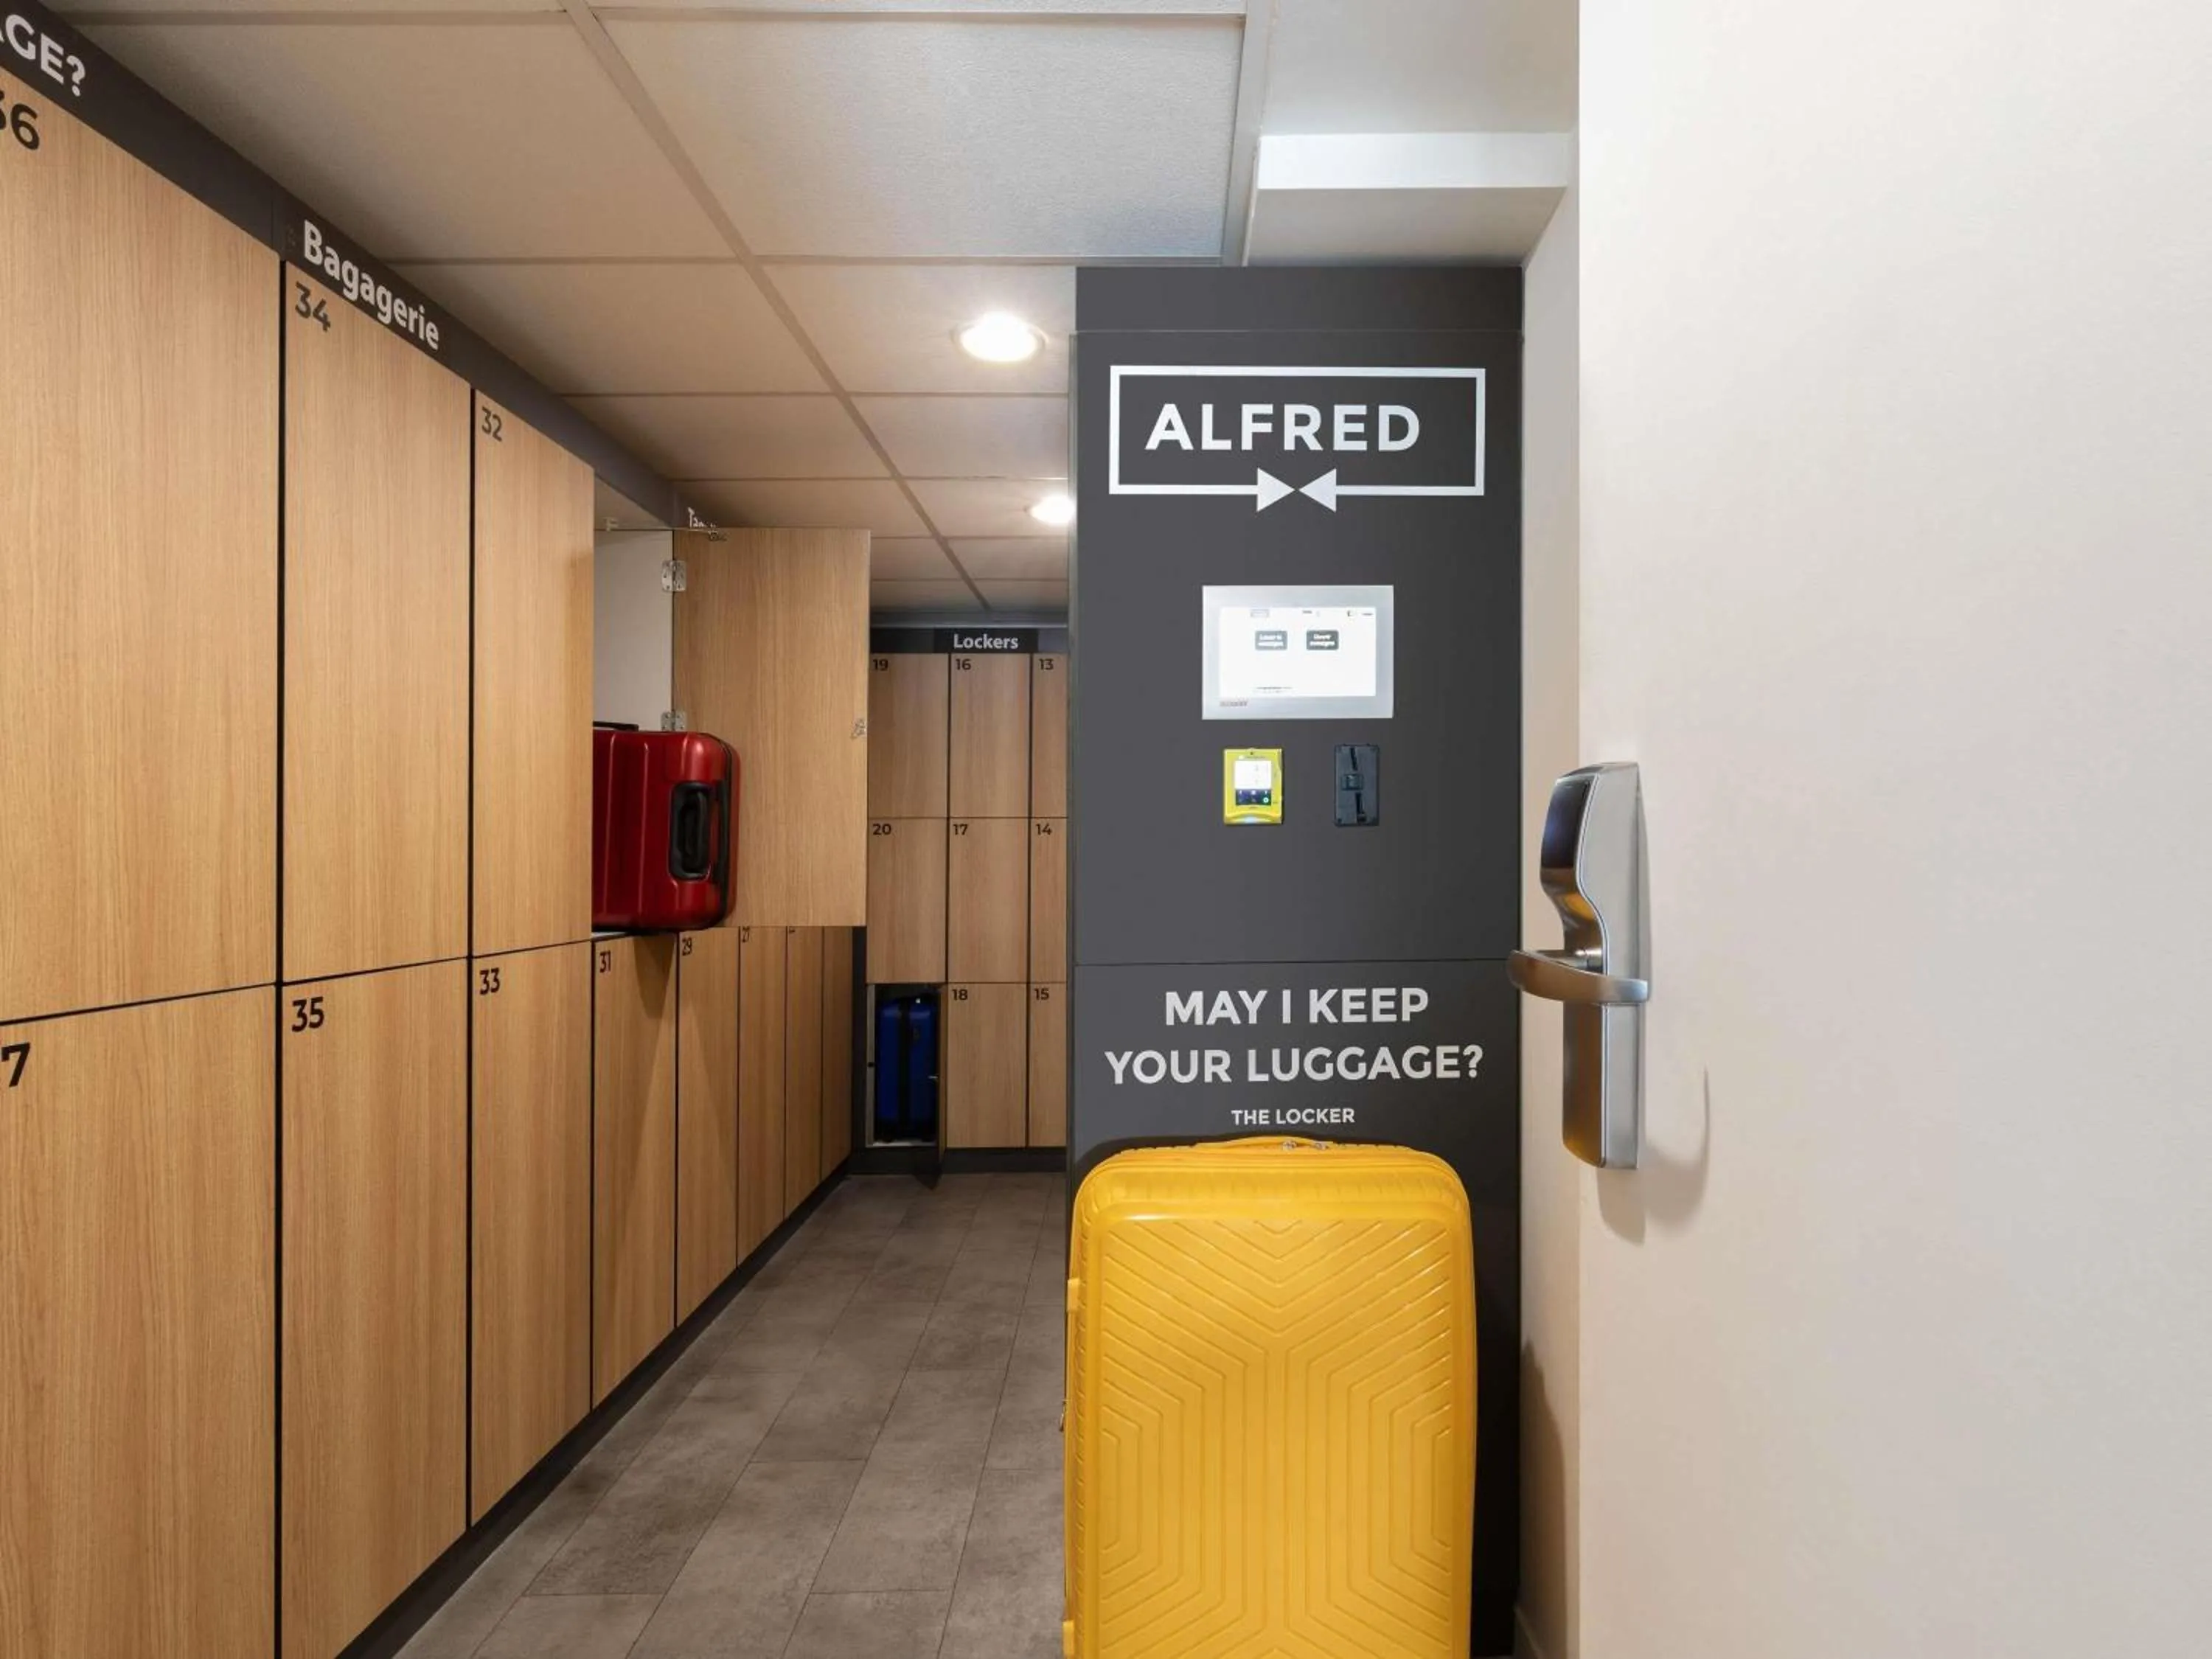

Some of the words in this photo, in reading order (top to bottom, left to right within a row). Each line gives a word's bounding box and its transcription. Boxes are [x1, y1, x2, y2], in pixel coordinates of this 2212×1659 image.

[0, 14, 86, 97] GE?
[304, 220, 439, 349] Bagagerie
[295, 282, 331, 332] 34
[481, 406, 502, 442] 32
[1145, 403, 1419, 451] ALFRED
[953, 633, 1019, 649] Lockers
[872, 658, 888, 671] 19
[956, 658, 971, 670] 16
[1039, 658, 1054, 670] 13
[872, 823, 891, 835] 20
[953, 824, 968, 835] 17
[1036, 824, 1052, 835] 14
[682, 937, 692, 956] 29
[599, 950, 611, 973] 31
[479, 967, 501, 995] 33
[952, 989, 968, 1001] 18
[1034, 988, 1049, 1001] 15
[291, 996, 324, 1032] 35
[1166, 990, 1267, 1026] MAY
[1282, 990, 1291, 1024] I
[1309, 987, 1429, 1023] KEEP
[1105, 1049, 1231, 1084] YOUR
[1248, 1044, 1483, 1082] LUGGAGE?
[1231, 1109, 1270, 1125] THE
[1276, 1107, 1354, 1124] LOCKER
